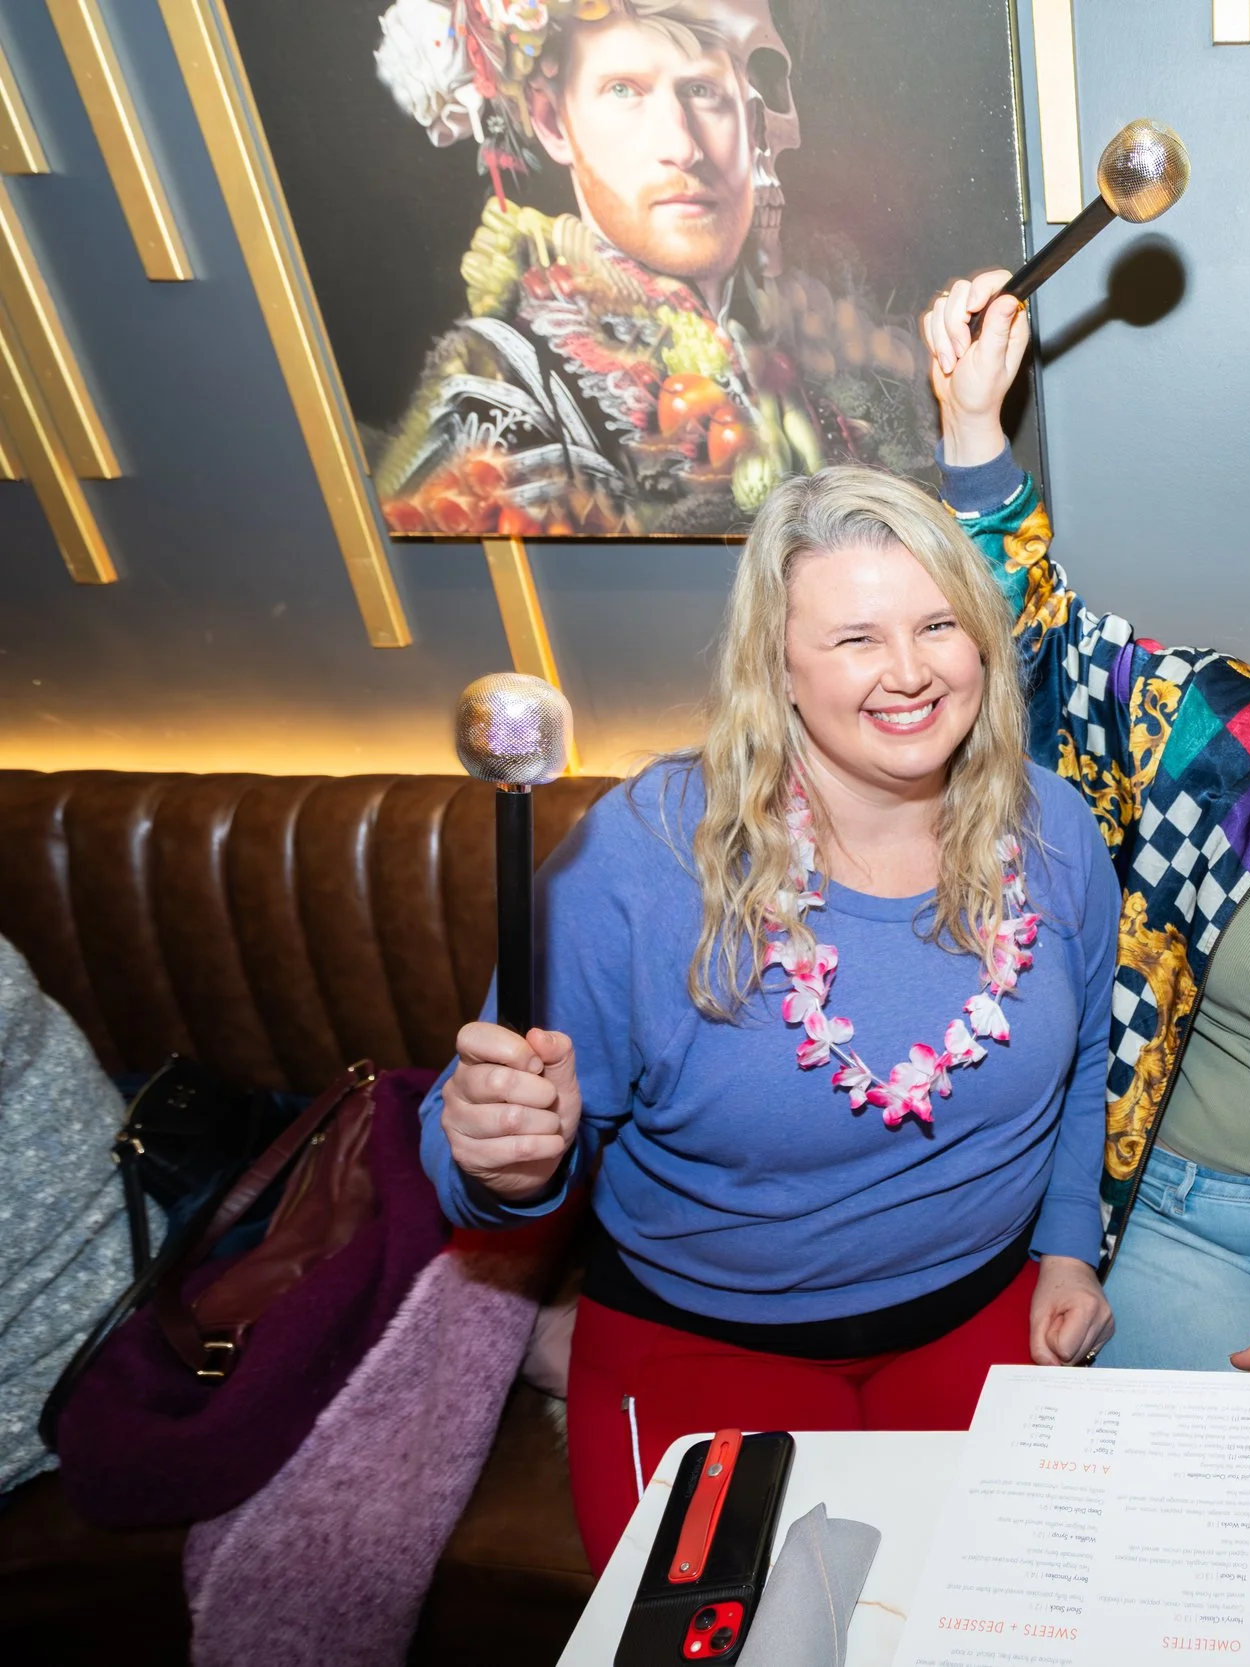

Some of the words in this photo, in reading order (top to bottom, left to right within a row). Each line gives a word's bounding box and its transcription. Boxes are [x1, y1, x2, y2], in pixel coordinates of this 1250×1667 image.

[1096, 1428, 1118, 1436] Sausage
[1038, 1459, 1077, 1472] CARTE
[1083, 1463, 1096, 1474] LA
[1102, 1465, 1111, 1475] A
[1187, 1472, 1211, 1480] Omelette
[1088, 1507, 1102, 1516] Deep
[1051, 1532, 1068, 1540] Syrup
[1194, 1548, 1214, 1556] pickled
[992, 1556, 1020, 1564] pancakes
[1046, 1573, 1072, 1582] Pancakes
[1074, 1574, 1089, 1584] Berry
[1236, 1574, 1247, 1582] The
[1050, 1605, 1066, 1613] Stack
[1066, 1606, 1082, 1615] Short
[1200, 1616, 1220, 1624] Classic
[1222, 1616, 1244, 1624] Harry's
[938, 1616, 1004, 1634] DESSERTS
[1024, 1624, 1078, 1640] SWEETS
[1162, 1636, 1241, 1652] OMELETTES
[1012, 1654, 1029, 1662] home
[1038, 1656, 1058, 1664] choice
